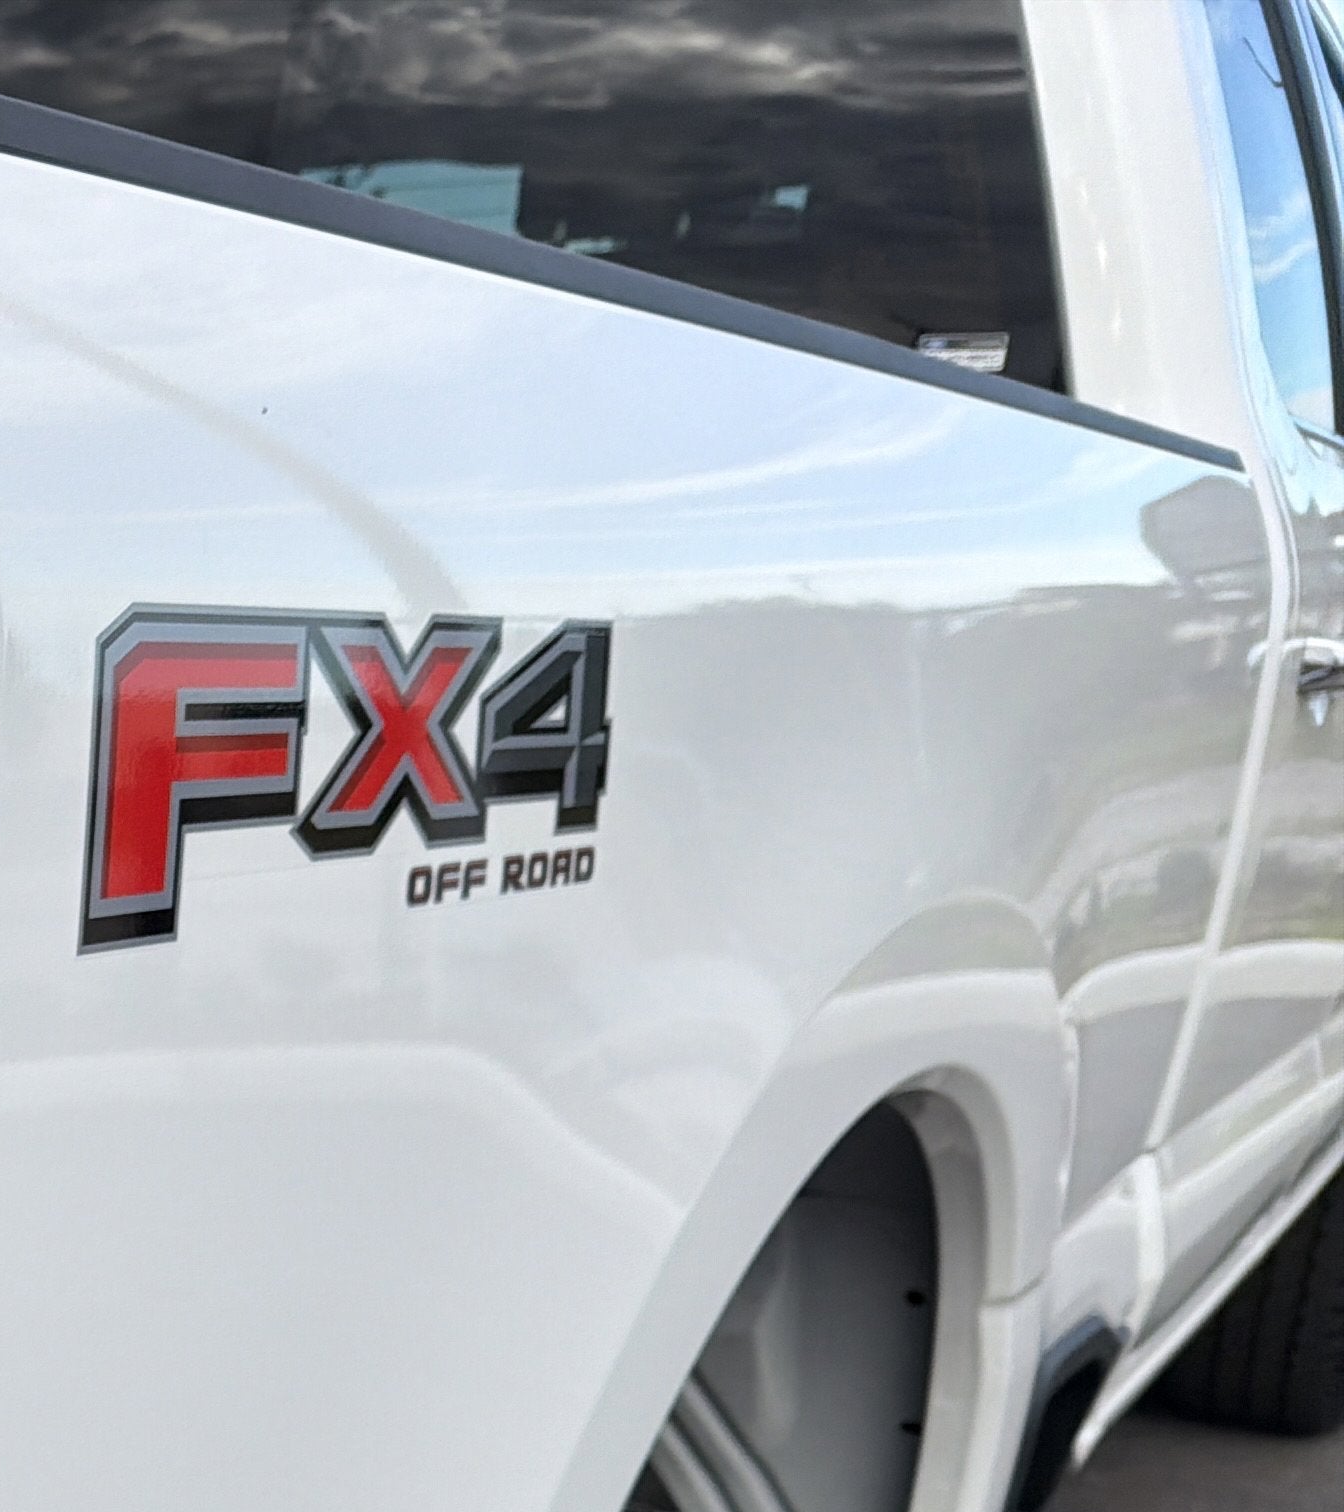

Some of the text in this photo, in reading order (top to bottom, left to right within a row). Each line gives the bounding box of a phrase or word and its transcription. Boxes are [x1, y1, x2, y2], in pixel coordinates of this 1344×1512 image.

[77, 602, 613, 956] FX4
[405, 846, 597, 908] OFF ROAD
